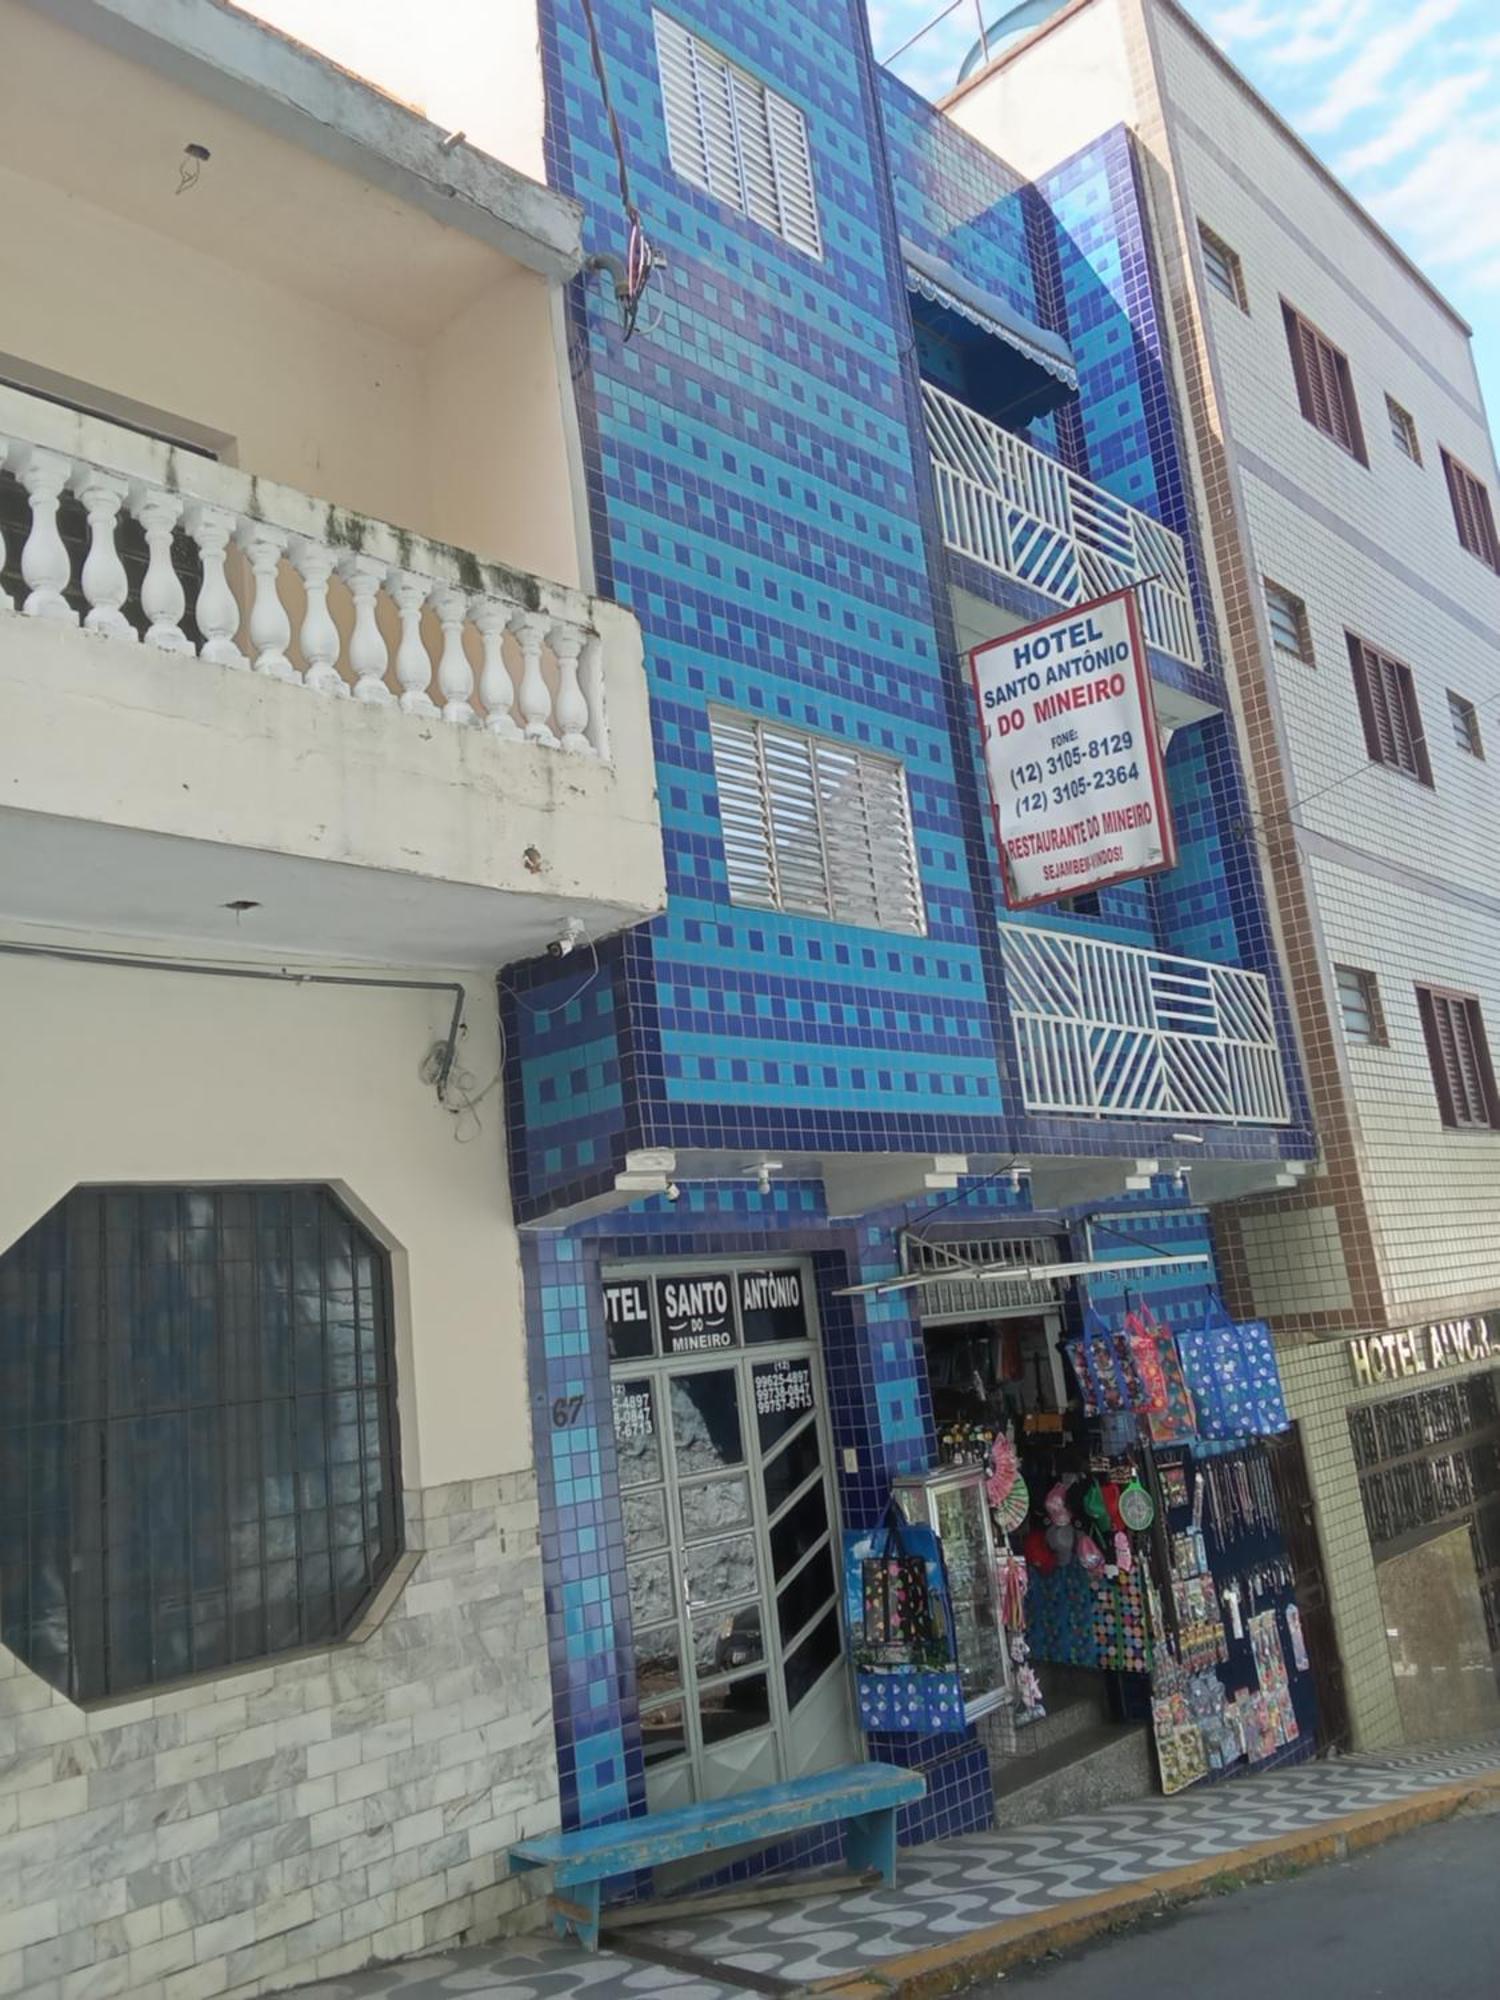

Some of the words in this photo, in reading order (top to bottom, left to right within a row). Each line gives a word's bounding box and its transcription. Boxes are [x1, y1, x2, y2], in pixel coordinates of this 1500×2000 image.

[1013, 618, 1103, 669] HOTEL
[984, 672, 1040, 709] SANTO
[1046, 641, 1129, 685] ANTÔNIO
[997, 709, 1025, 736] DO
[1033, 673, 1125, 723] MINEIRO
[1011, 761, 1043, 790] (12)
[1047, 731, 1133, 775] 3105-8129
[1051, 729, 1078, 749] FONE:
[1016, 790, 1048, 818] (12)
[1052, 761, 1139, 804] 3105-2364
[1007, 821, 1087, 860] RESTAURANTE
[1087, 815, 1100, 839] DO
[1102, 801, 1152, 834] MINEIRO
[665, 1281, 727, 1318] SANTO
[744, 1271, 800, 1311] ANTÔNIO
[672, 1332, 731, 1352] MINEIRO
[691, 1318, 703, 1332] DO
[1350, 1329, 1426, 1385] HOTEL
[553, 1394, 585, 1428] 67
